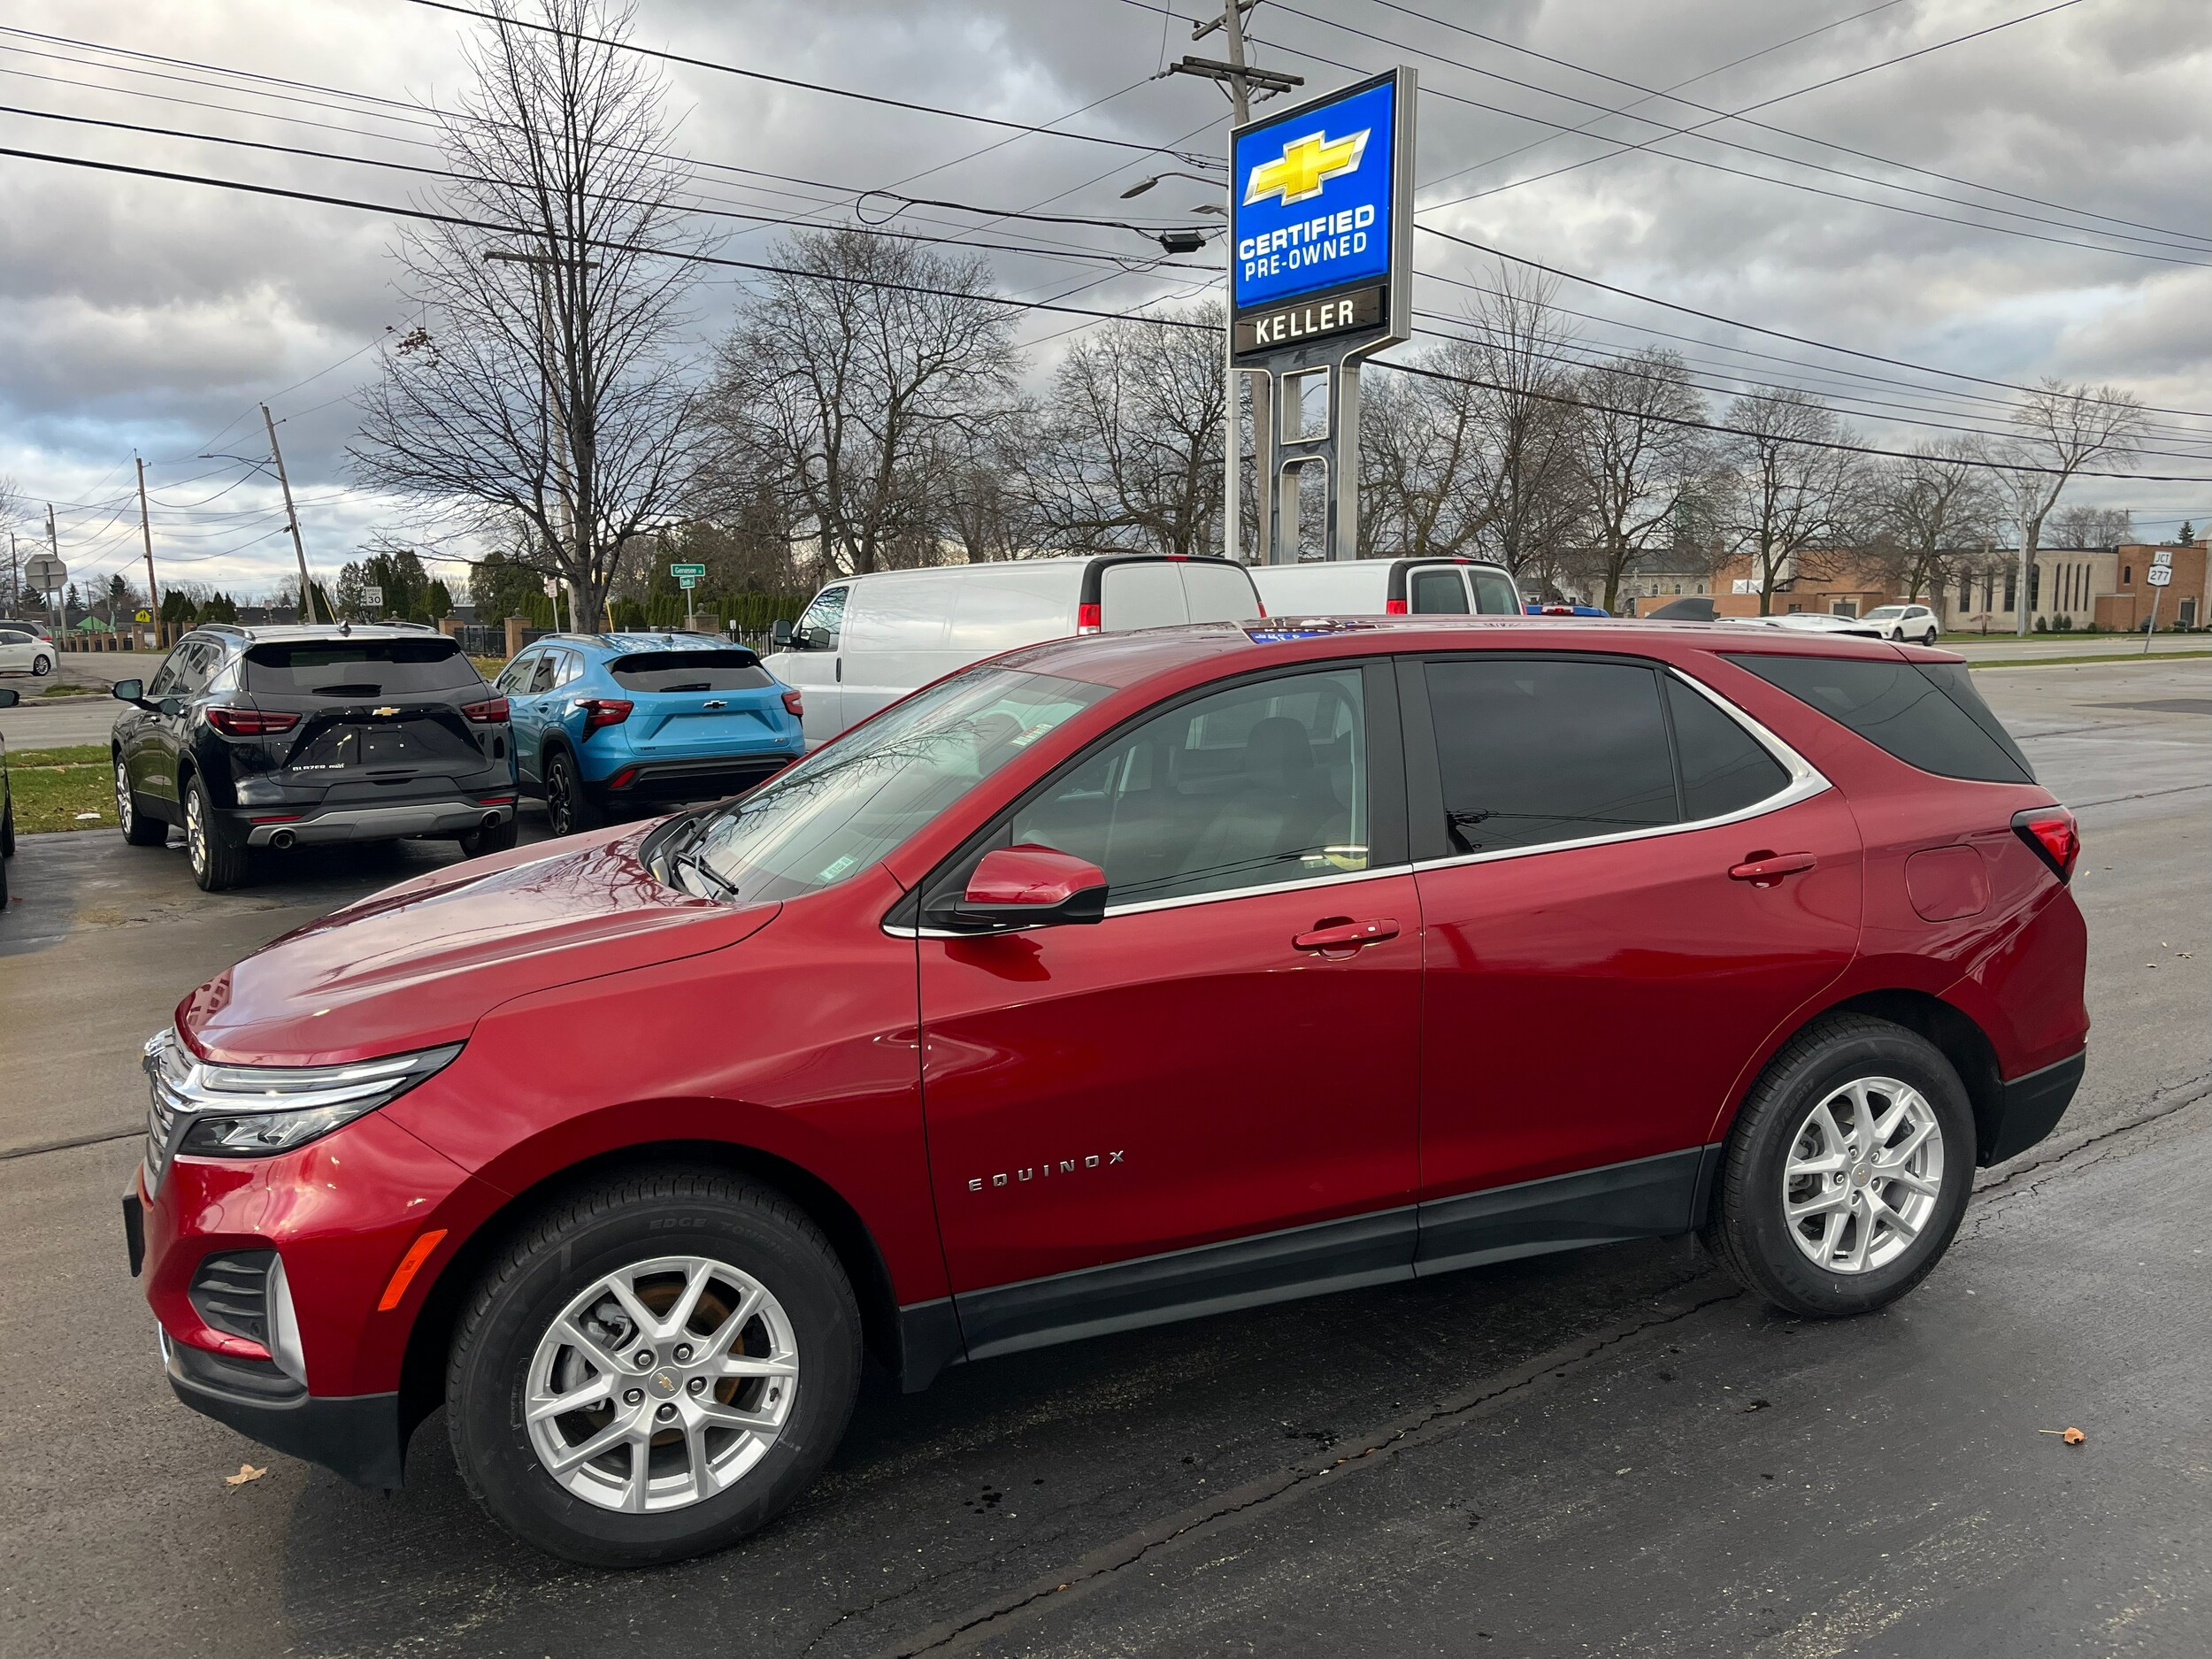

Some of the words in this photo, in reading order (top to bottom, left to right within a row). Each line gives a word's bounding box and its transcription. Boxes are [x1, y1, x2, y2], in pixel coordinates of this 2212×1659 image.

[1239, 204, 1375, 261] CERTIFIED
[1245, 232, 1367, 282] PRE-OWNED
[1256, 300, 1354, 344] KELLER
[2150, 570, 2170, 581] 277
[2155, 553, 2170, 563] JCT
[968, 1150, 1125, 1192] EQUINOX
[649, 1217, 707, 1230] EDGE
